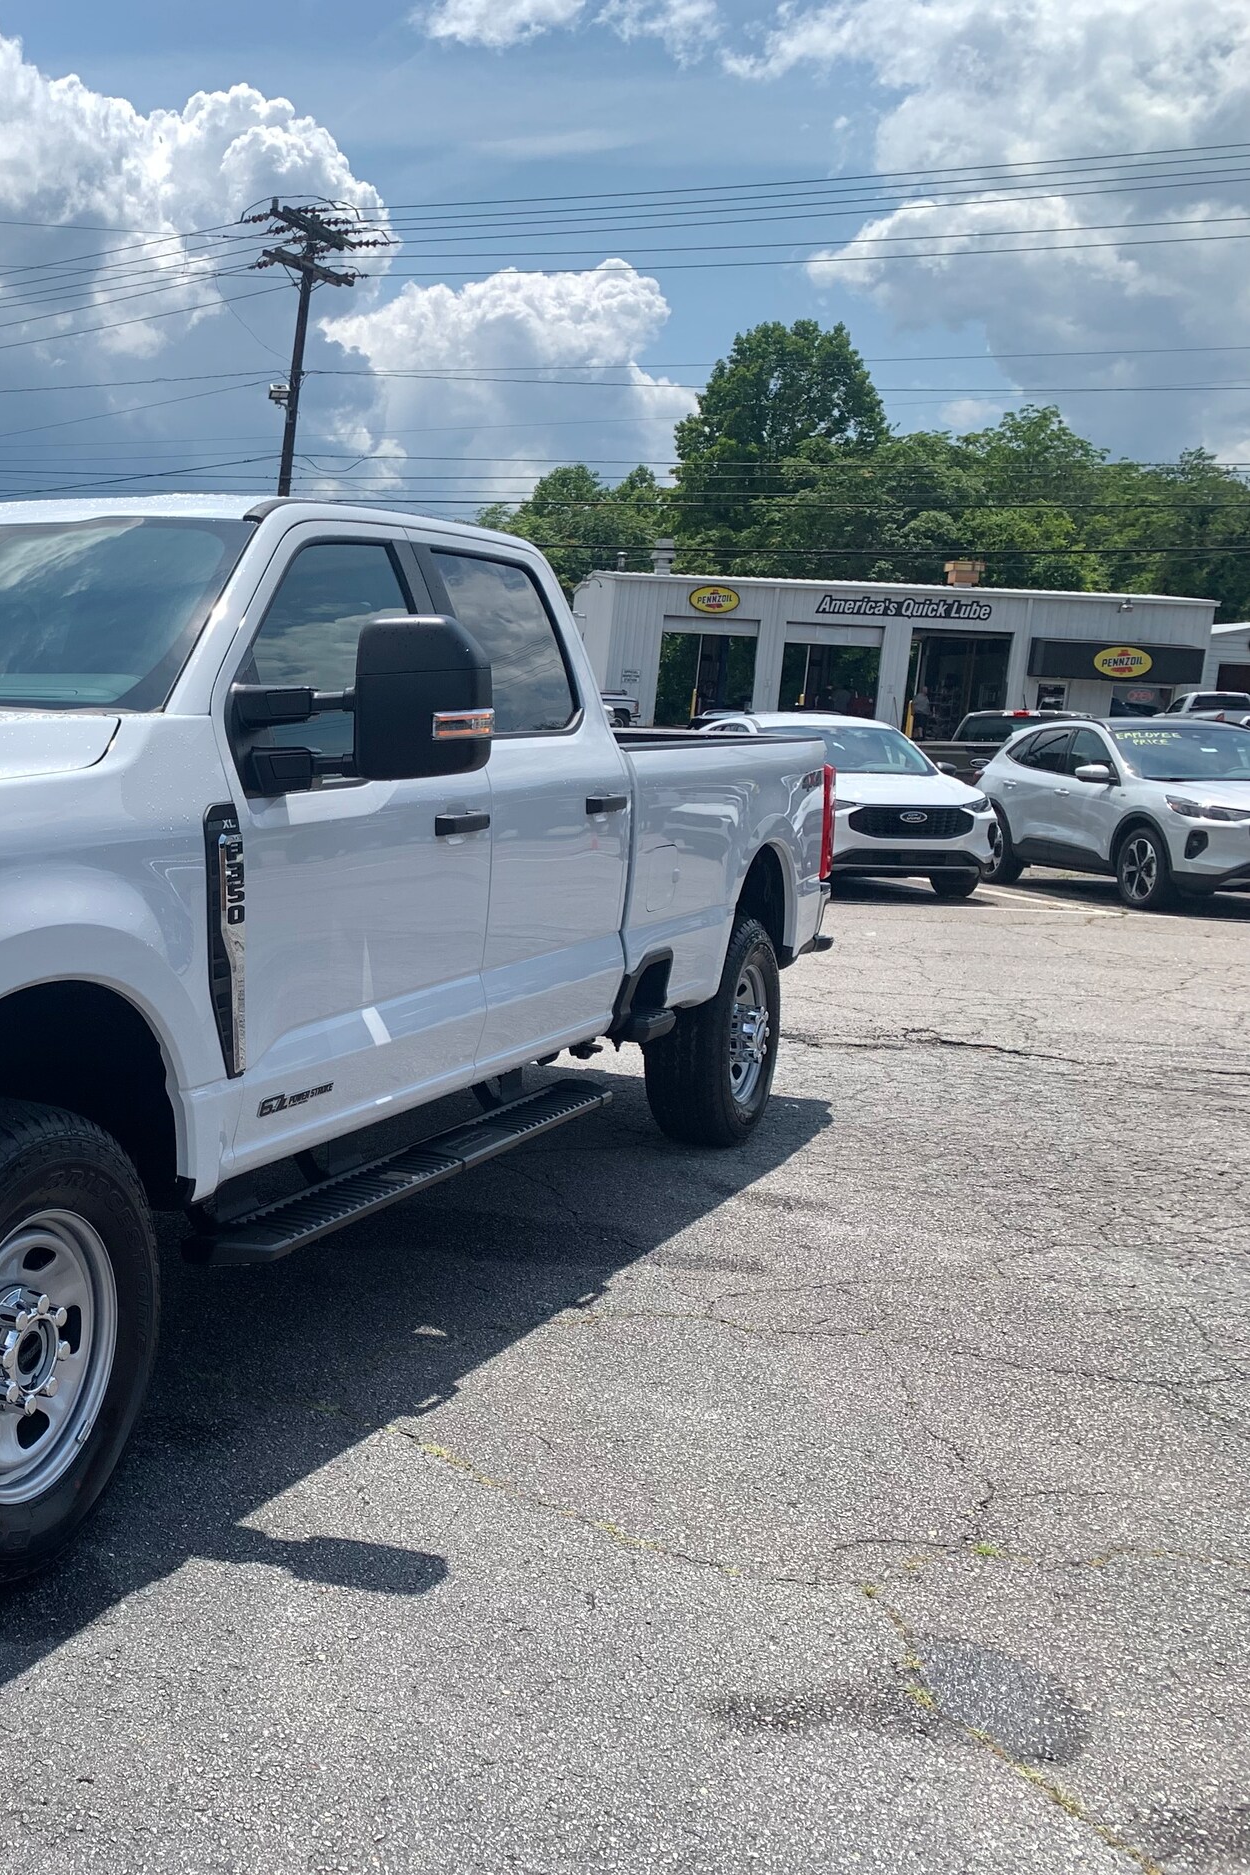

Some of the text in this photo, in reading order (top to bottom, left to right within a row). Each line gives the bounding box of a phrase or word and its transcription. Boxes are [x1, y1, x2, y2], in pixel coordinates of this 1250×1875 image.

[696, 594, 733, 604] PENNZOIL
[818, 597, 992, 620] America's Quick Lube
[1101, 656, 1144, 668] PENNZOIL
[1115, 732, 1183, 740] EMPLOYEE
[222, 819, 237, 830] XL
[310, 1082, 335, 1098] STROKE
